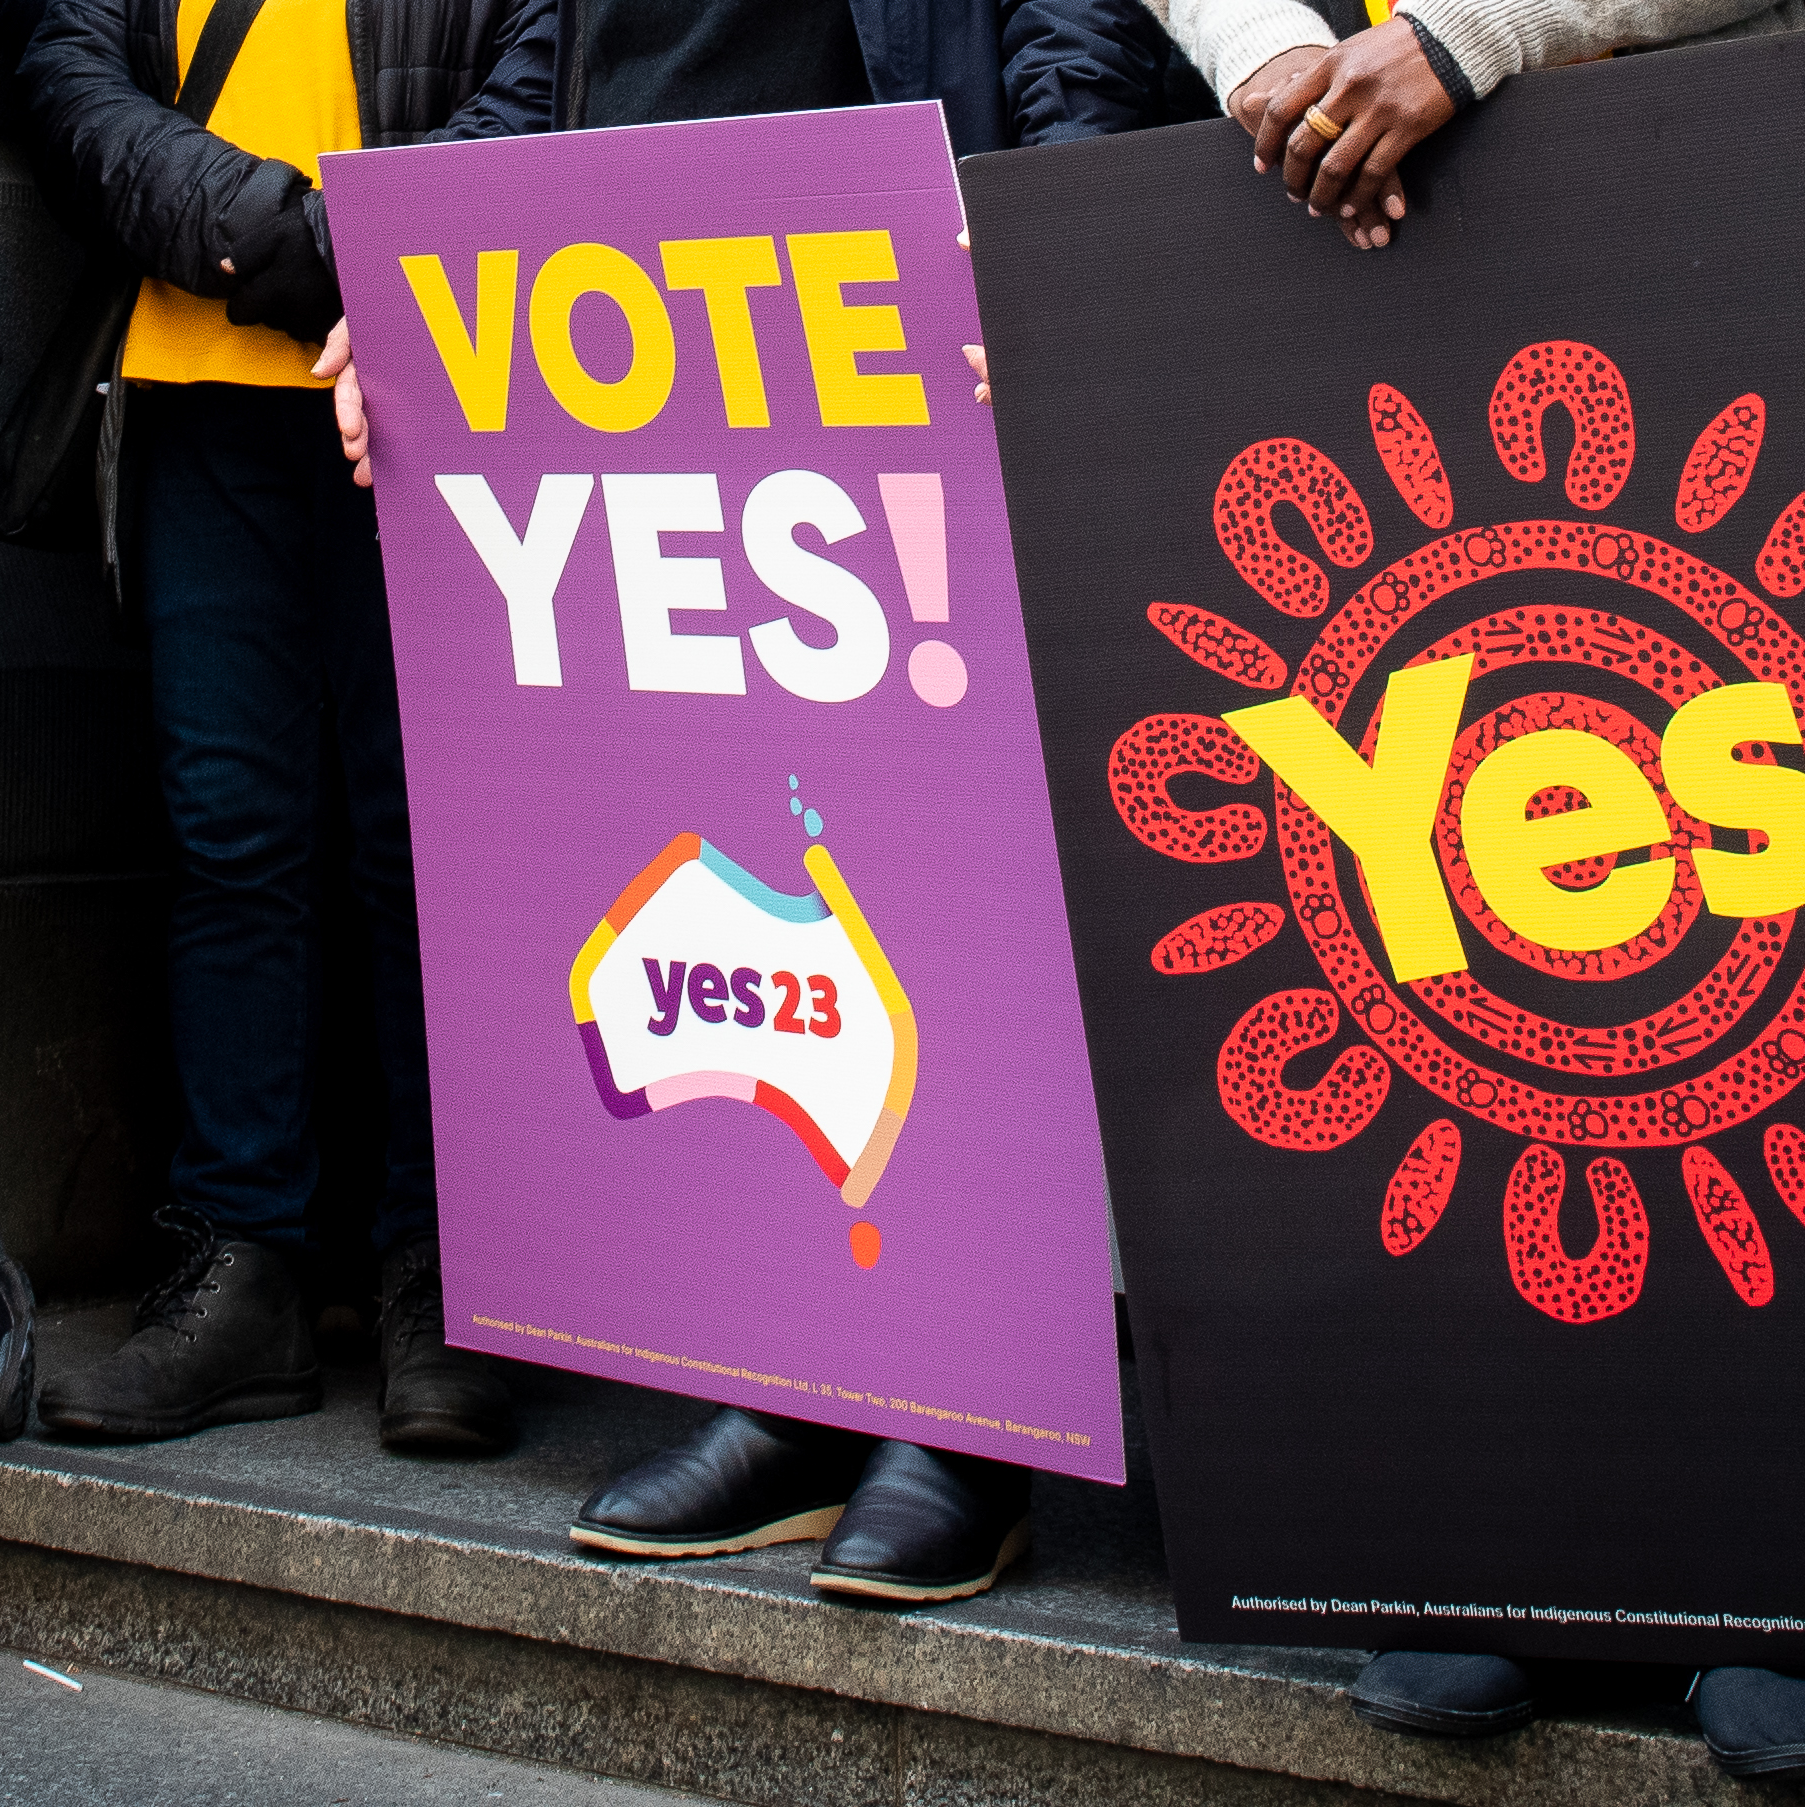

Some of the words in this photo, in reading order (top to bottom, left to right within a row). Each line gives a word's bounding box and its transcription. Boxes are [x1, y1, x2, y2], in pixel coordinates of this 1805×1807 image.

[398, 228, 932, 434] VOTE
[433, 468, 969, 709] YES!
[641, 957, 842, 1039] yes23
[1231, 1594, 1307, 1611] Authorised
[1310, 1596, 1328, 1616] by
[1330, 1598, 1368, 1614] Dean
[1370, 1599, 1420, 1618] Parkin,
[1423, 1601, 1503, 1620] Australians
[1506, 1604, 1526, 1620] for
[1530, 1605, 1612, 1625] Indigenous
[1615, 1608, 1720, 1628] Constitutional
